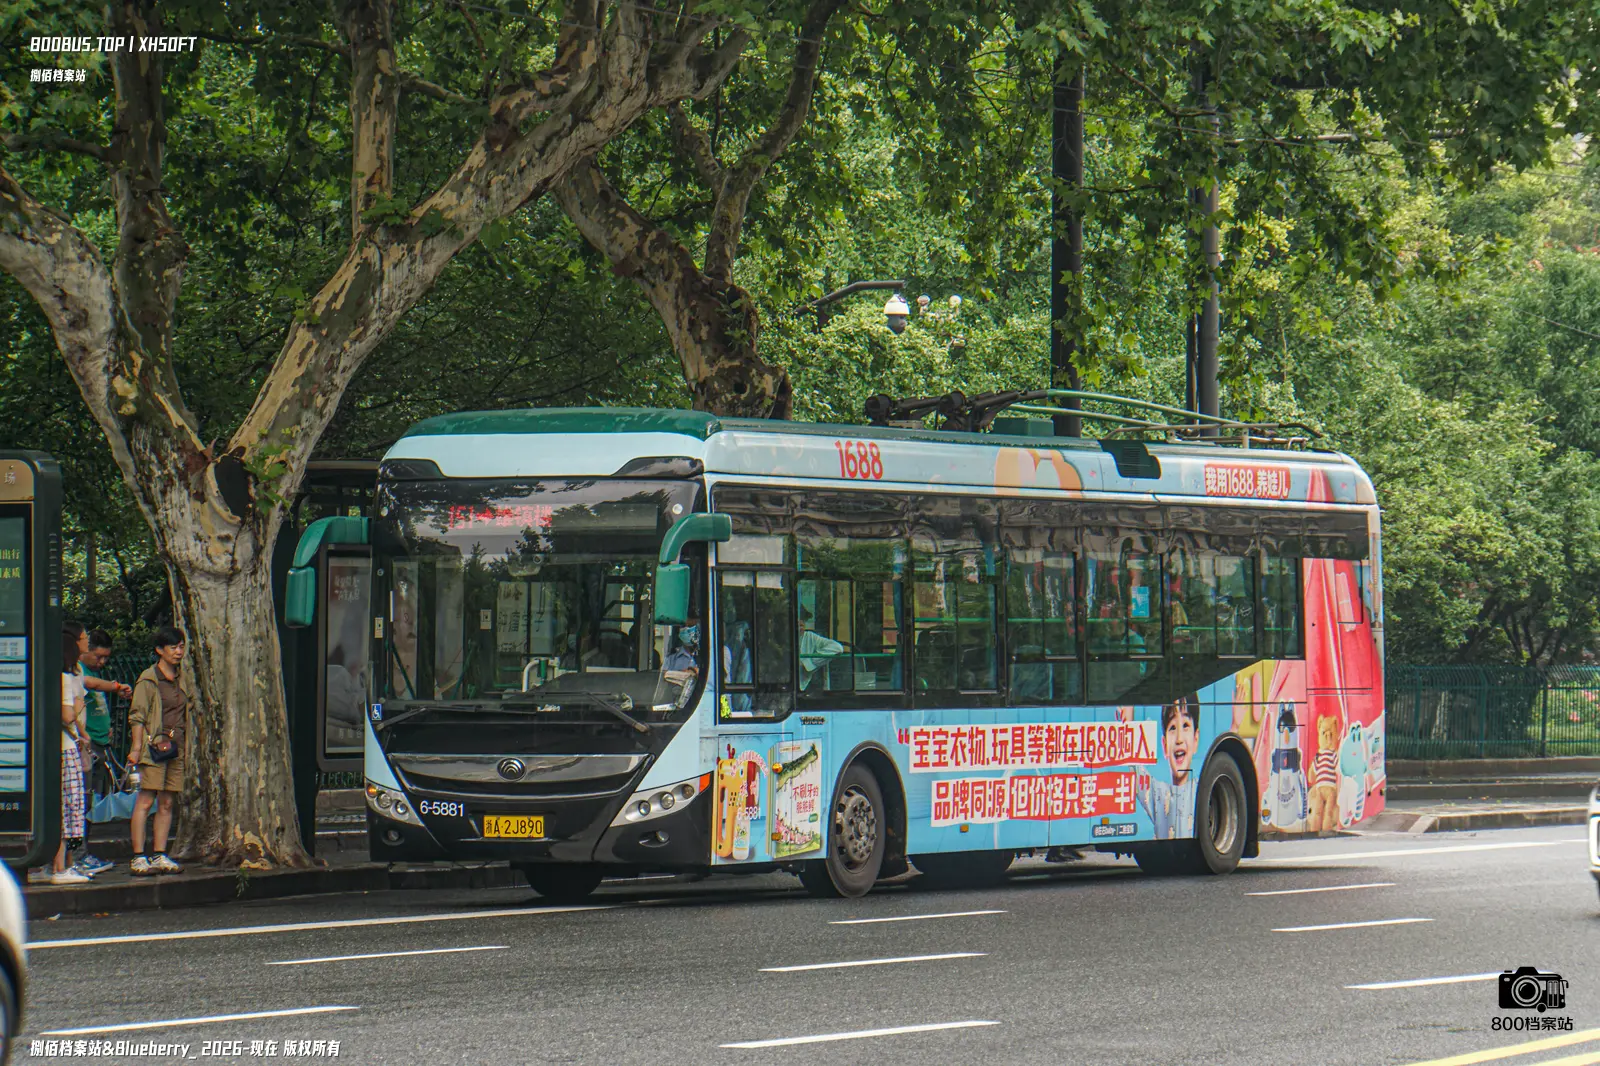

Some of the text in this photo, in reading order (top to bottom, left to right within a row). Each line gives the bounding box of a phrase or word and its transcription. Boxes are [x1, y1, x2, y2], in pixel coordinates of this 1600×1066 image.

[834, 440, 884, 480] 1688
[4, 472, 17, 485] 场
[420, 800, 464, 817] 6-5881
